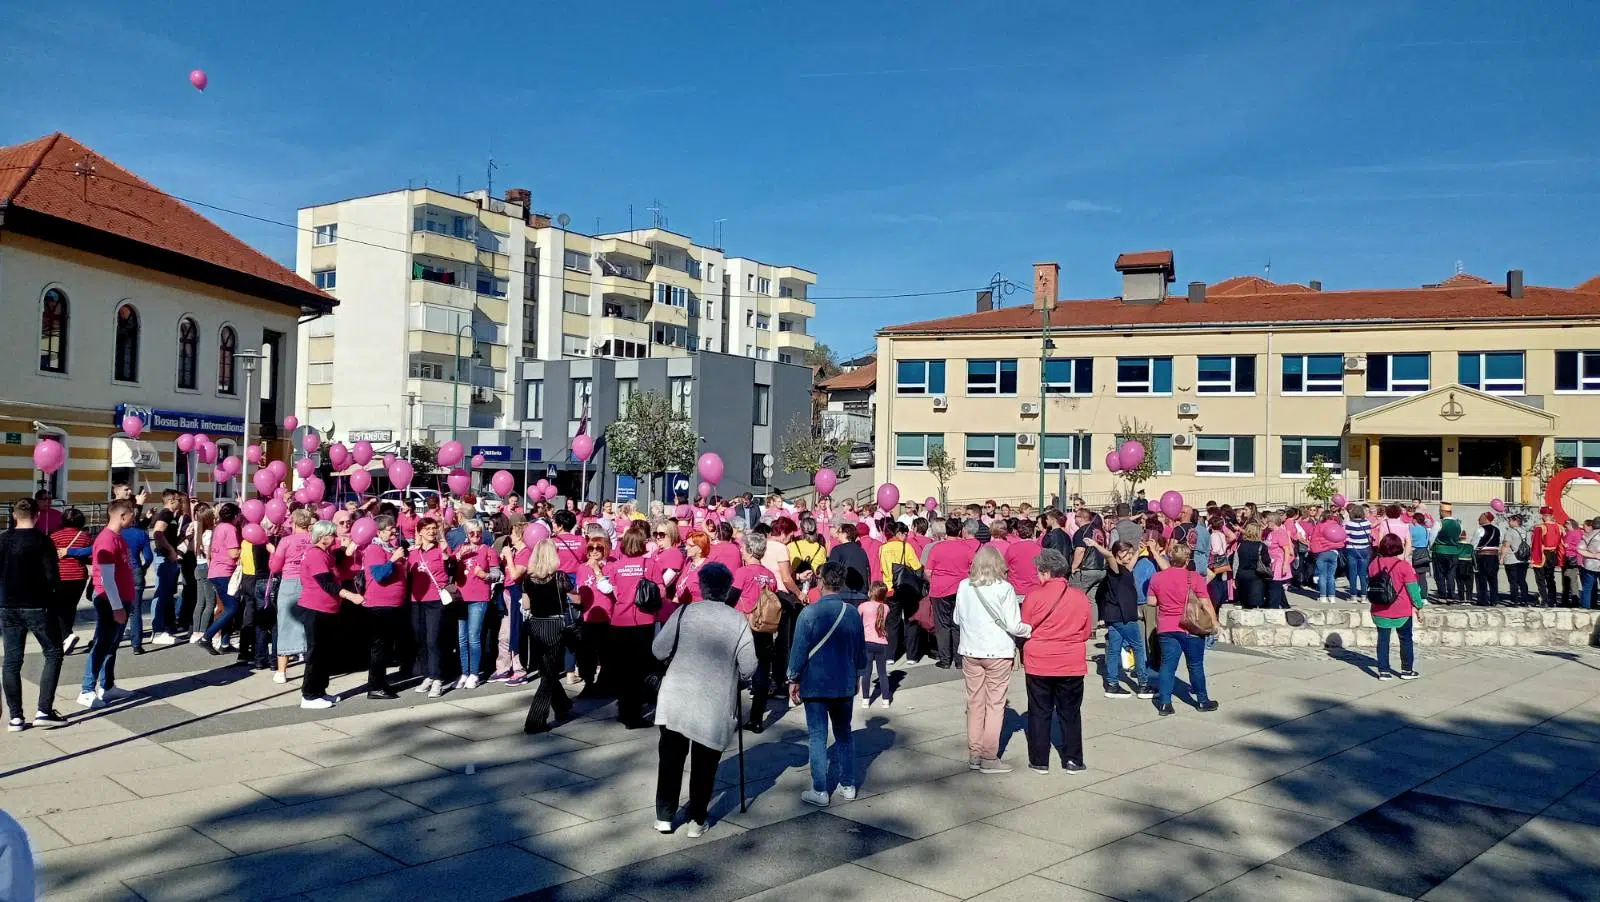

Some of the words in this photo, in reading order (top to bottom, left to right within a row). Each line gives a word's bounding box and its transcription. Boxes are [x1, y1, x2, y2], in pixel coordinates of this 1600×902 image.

[154, 415, 178, 427] Bosna
[180, 417, 199, 429] Bank
[201, 420, 246, 433] Internationa
